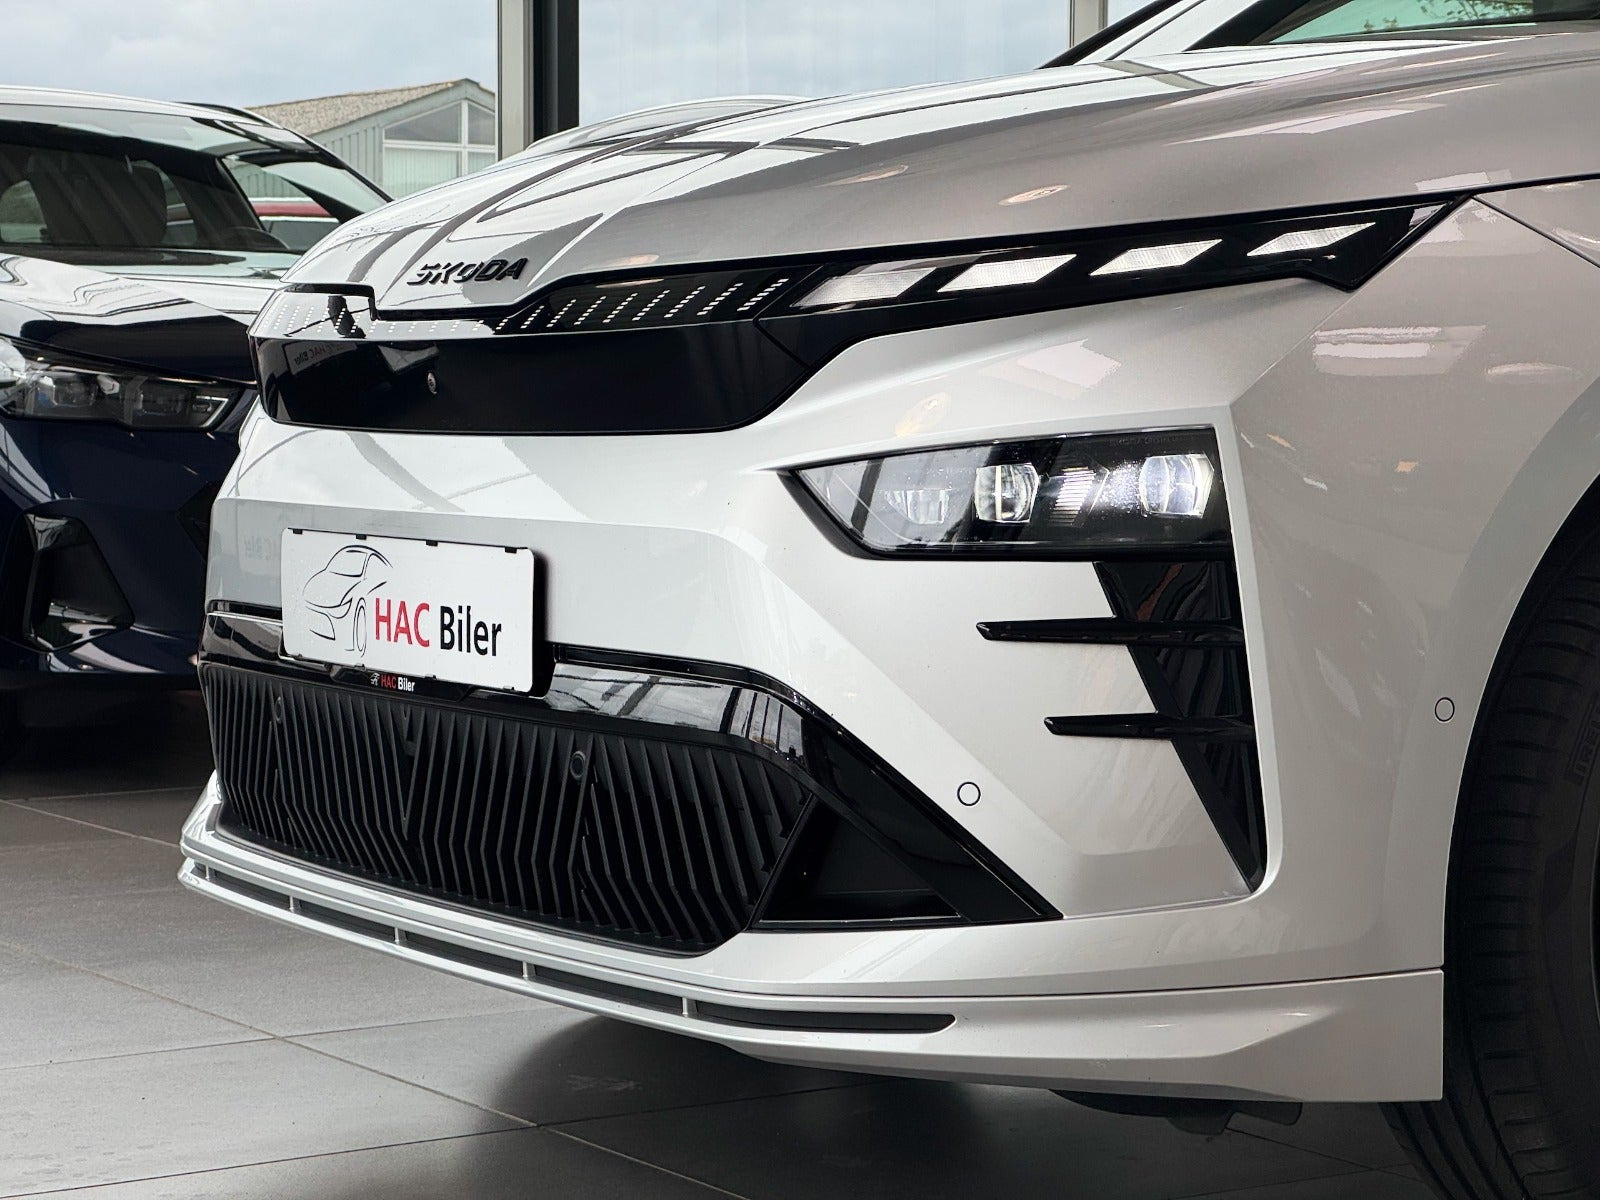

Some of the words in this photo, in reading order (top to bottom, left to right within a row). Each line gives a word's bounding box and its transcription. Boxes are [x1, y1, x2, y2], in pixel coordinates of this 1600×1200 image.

[375, 597, 430, 648] HAC
[439, 605, 502, 657] Biler
[380, 674, 397, 689] HAC
[397, 676, 416, 692] Biler
